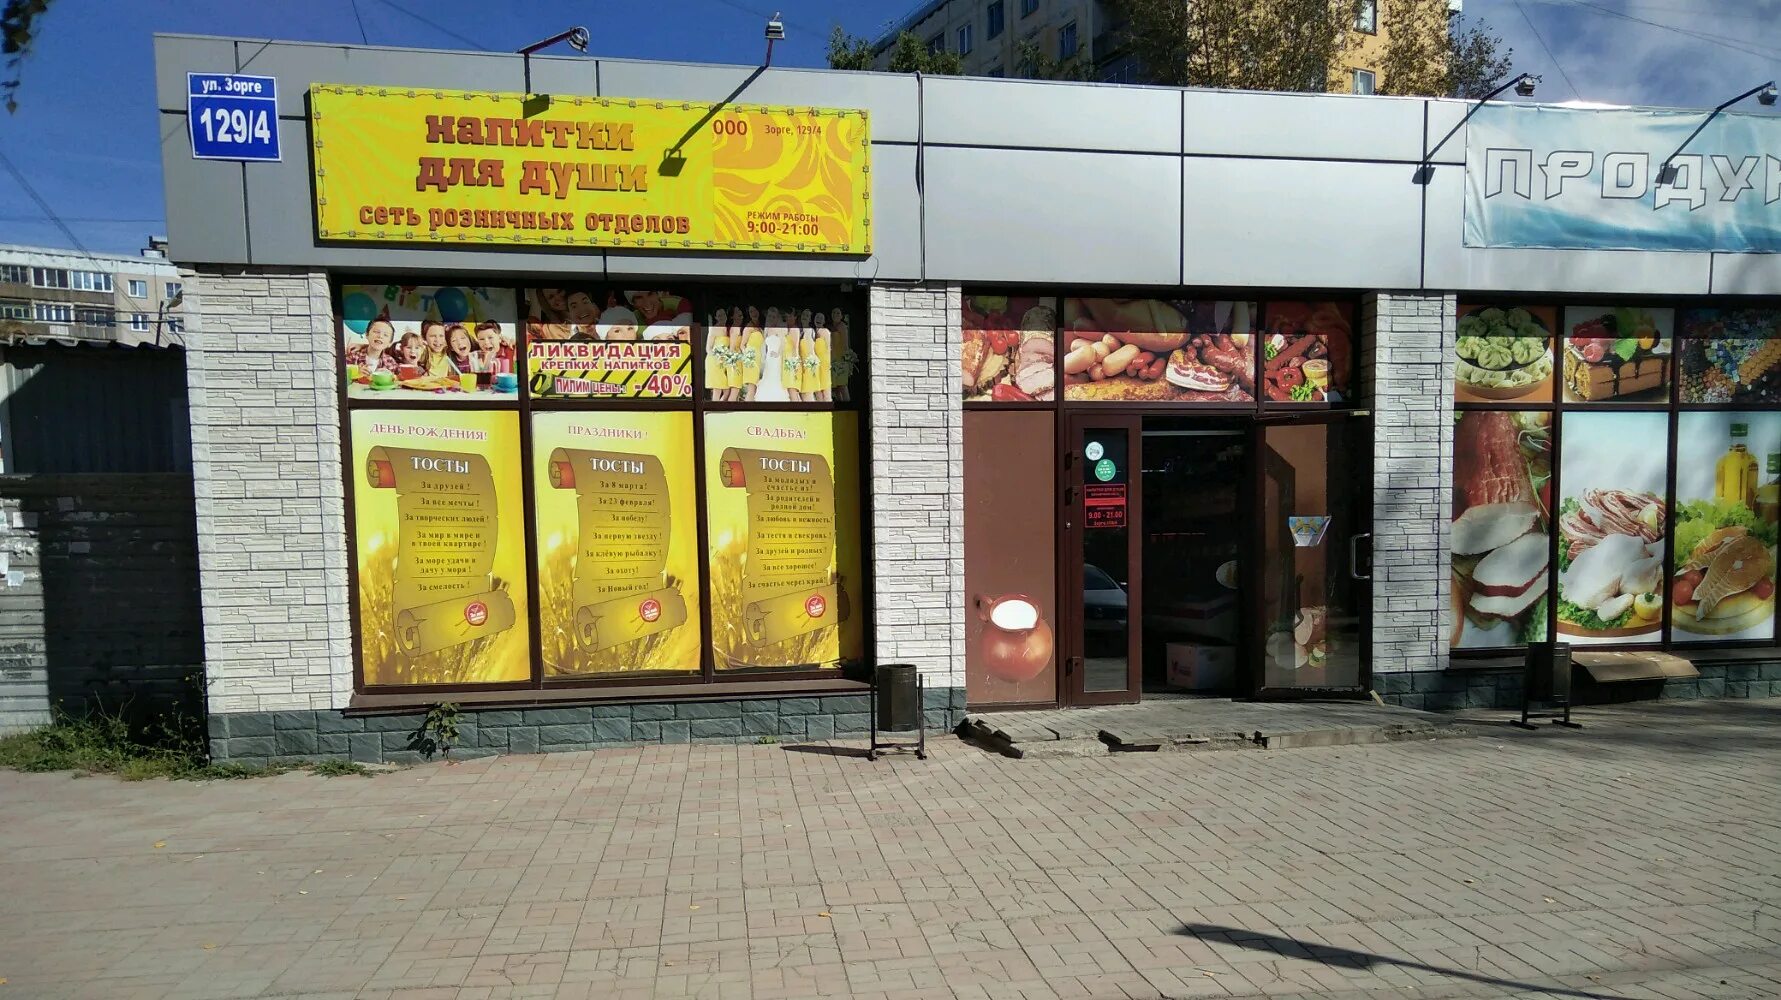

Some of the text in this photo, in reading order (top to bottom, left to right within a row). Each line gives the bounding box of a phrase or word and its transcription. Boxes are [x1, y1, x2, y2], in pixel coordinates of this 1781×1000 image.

[202, 77, 262, 94] ул. Зорге
[200, 108, 271, 145] 129/4
[765, 124, 822, 137] Зорге, 129/4
[747, 211, 819, 223] РЕЖИМ РАБОТЫ
[747, 221, 819, 236] 9:00-21:00
[532, 344, 681, 360] ЛИКВИДАЦИЯ
[541, 361, 671, 370] КРЕПКИХ НАПИТКОВ
[556, 377, 590, 393] ПИЛИМ
[370, 424, 487, 440] ДЕНЬ РОЖДЕНИЯ!
[747, 426, 806, 439] СВАДЬБА!
[411, 456, 469, 474] ТОСТЫ
[590, 458, 644, 474] ТОСТЫ
[760, 457, 810, 473] ТОСТЫ
[421, 481, 431, 489] За
[416, 515, 459, 523] творческих
[429, 532, 444, 540] мир
